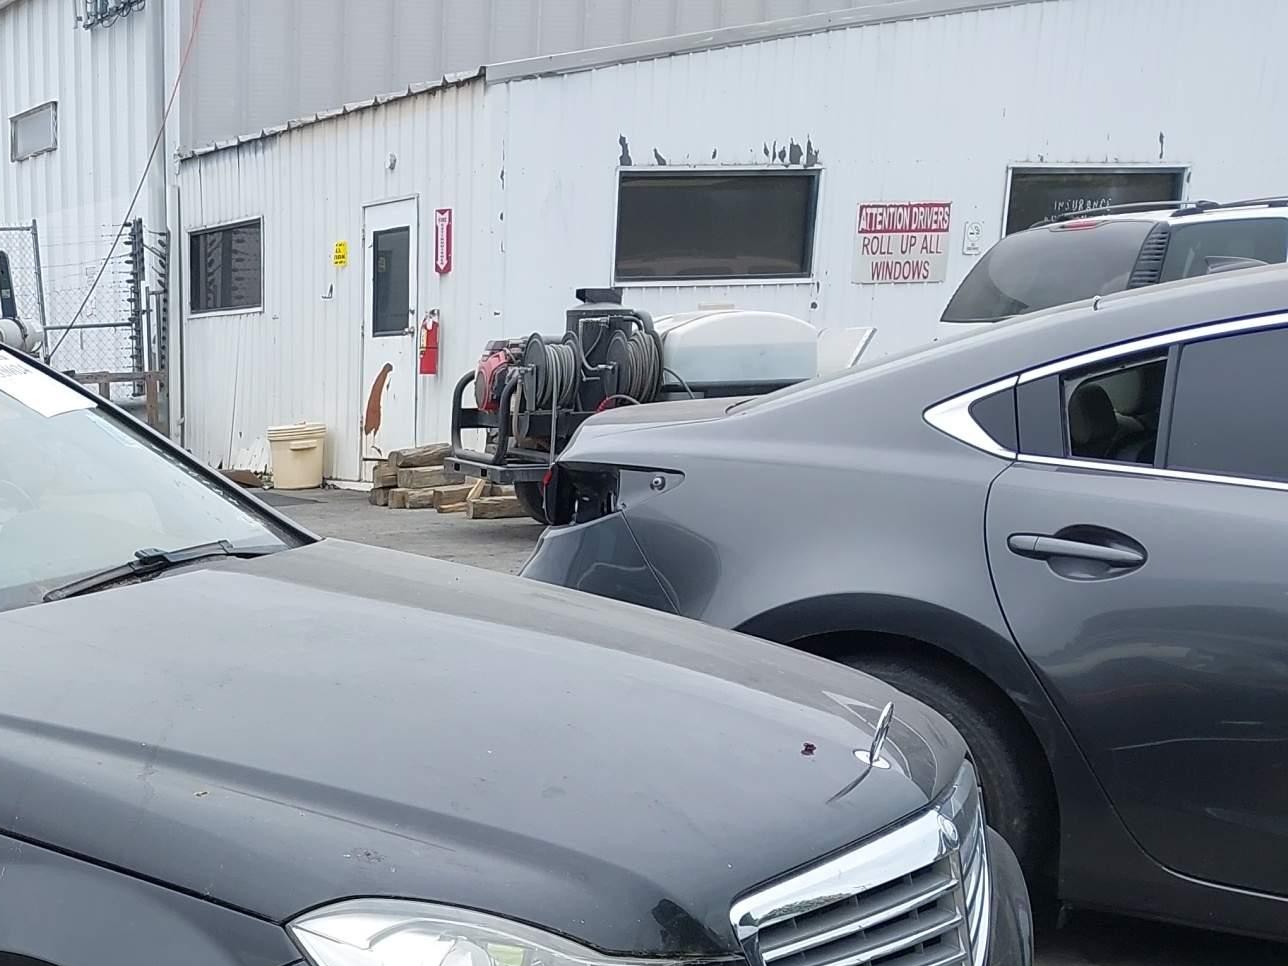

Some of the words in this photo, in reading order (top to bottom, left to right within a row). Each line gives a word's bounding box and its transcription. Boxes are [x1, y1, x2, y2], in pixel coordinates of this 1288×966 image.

[859, 207, 909, 231] ATTENTION
[912, 206, 949, 230] DRIVERS
[862, 236, 893, 255] ROLL
[900, 235, 917, 255] UP
[920, 234, 942, 254] ALL
[871, 260, 930, 281] WINDOWS
